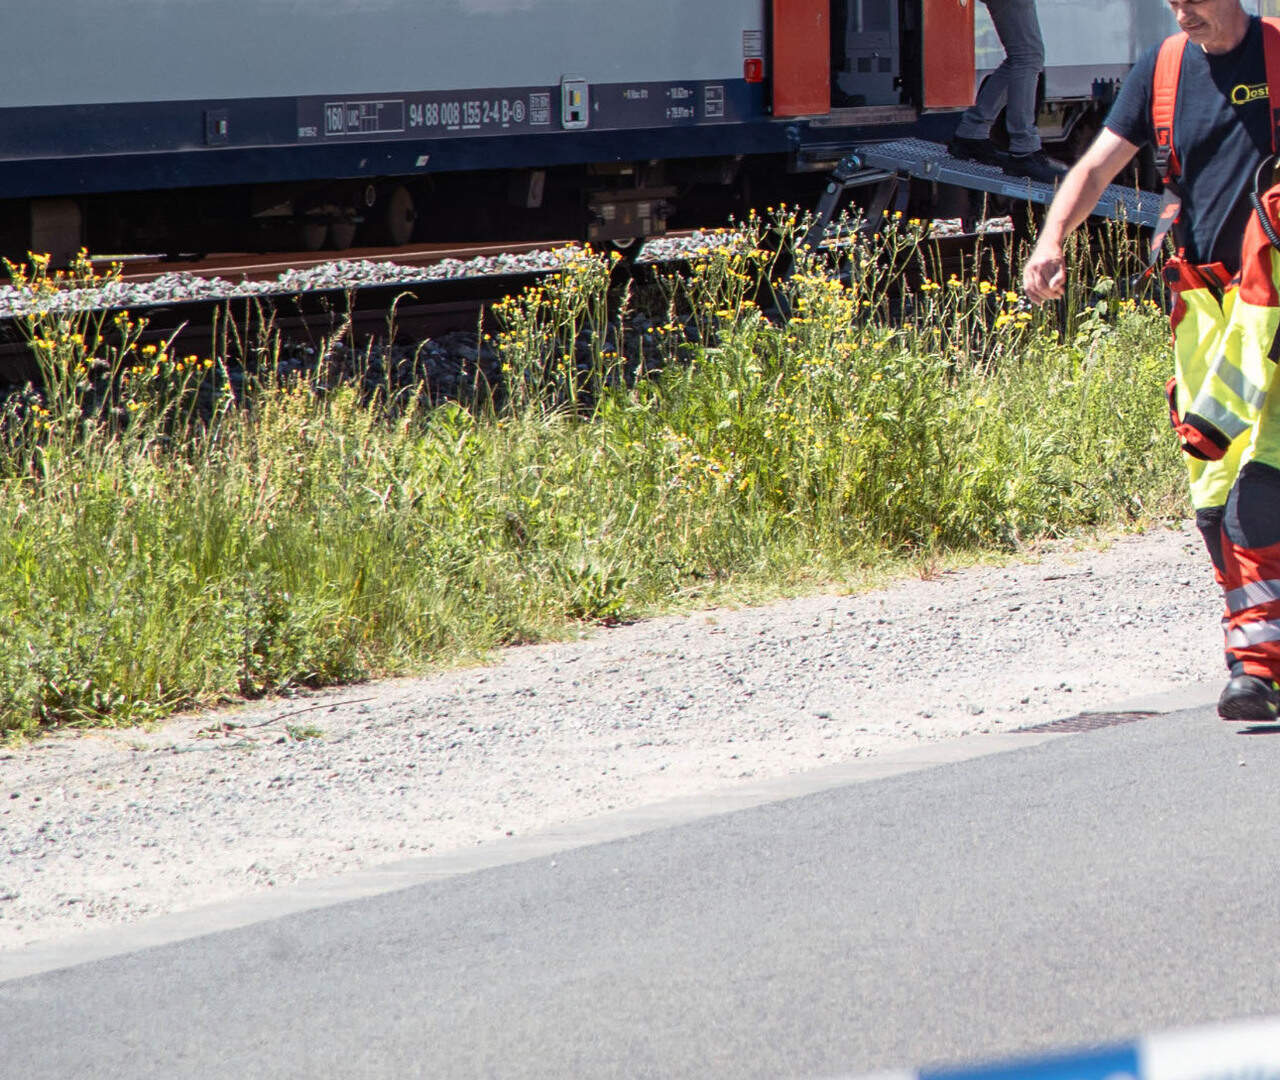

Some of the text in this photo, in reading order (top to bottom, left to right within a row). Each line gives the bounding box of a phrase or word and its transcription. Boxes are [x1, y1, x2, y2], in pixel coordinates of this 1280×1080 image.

[327, 107, 344, 131] 160
[409, 103, 423, 127] 94
[425, 102, 439, 126] 88
[441, 101, 460, 125] 008
[462, 99, 481, 124] 155
[482, 100, 500, 123] 2-4
